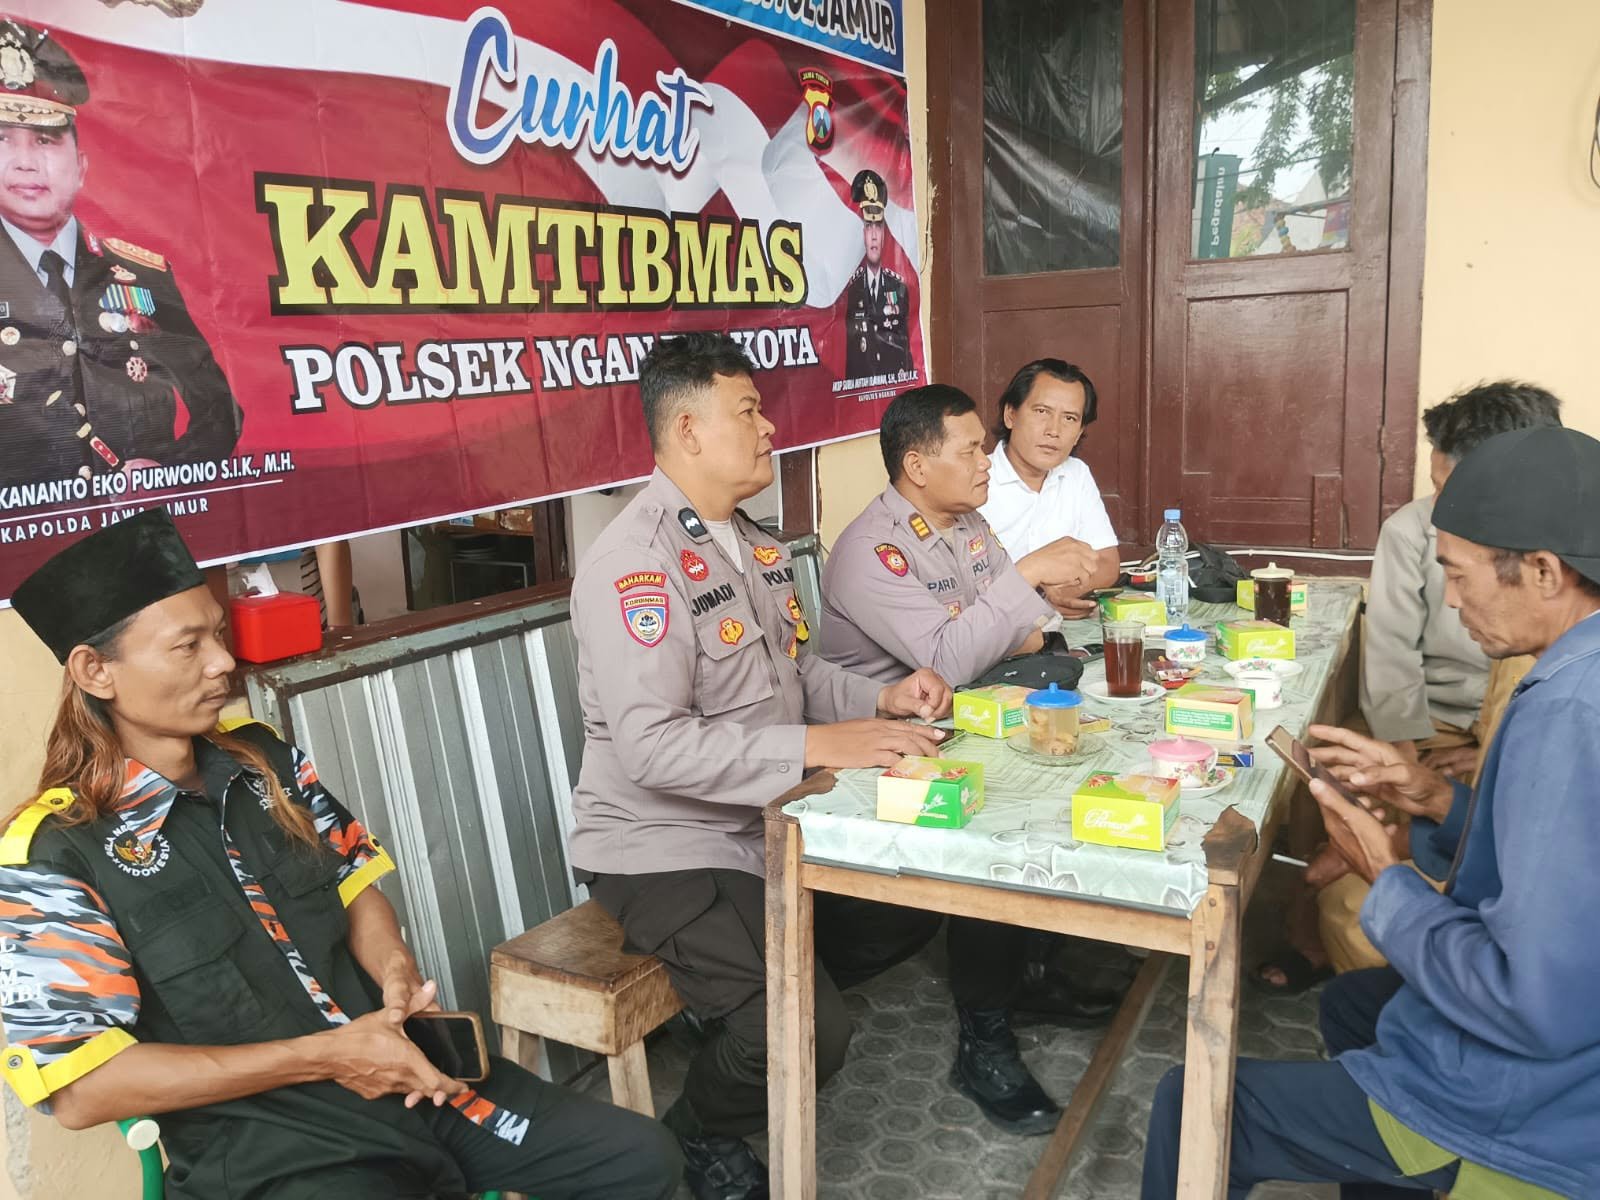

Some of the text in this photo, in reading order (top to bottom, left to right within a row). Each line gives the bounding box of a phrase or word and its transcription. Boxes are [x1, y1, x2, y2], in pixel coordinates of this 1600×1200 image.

[449, 9, 711, 168] Curhat
[259, 178, 807, 311] KAMTIBMAS
[284, 326, 819, 411] POLSEK NGAN KOTA
[92, 472, 127, 497] EKO
[131, 458, 218, 491] PURWONO
[264, 451, 296, 474] M.H.
[1, 497, 209, 544] KAPOLDA JAW IMUR
[618, 574, 662, 589] BAHARKAM
[972, 556, 990, 577] POL
[691, 582, 737, 617] JUMADI
[117, 839, 170, 877] INDONESIA
